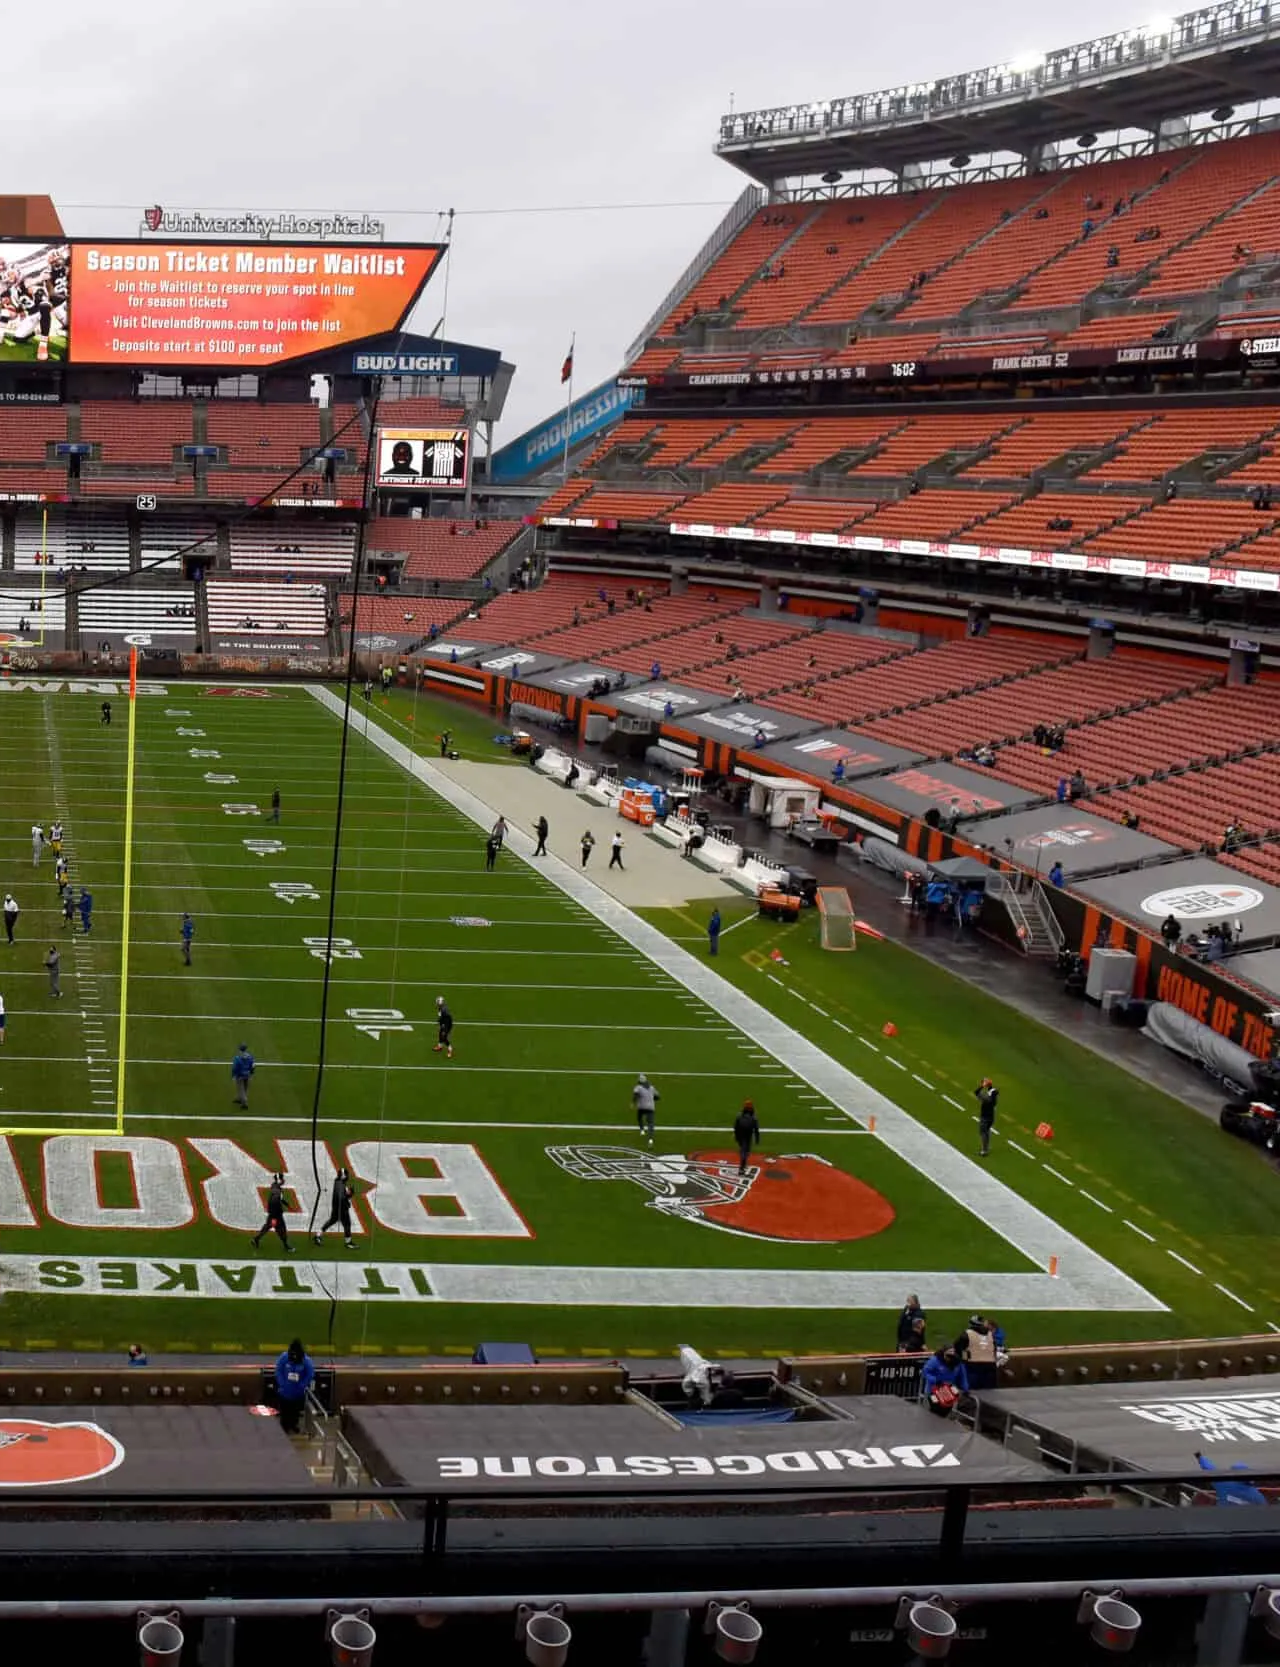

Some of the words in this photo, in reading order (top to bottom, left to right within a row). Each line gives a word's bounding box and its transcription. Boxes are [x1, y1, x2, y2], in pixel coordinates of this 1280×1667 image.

[163, 214, 271, 239] University
[278, 215, 380, 238] Hospitals
[87, 251, 160, 272] Season
[166, 252, 230, 273] Ticket
[235, 252, 318, 274] Member
[323, 253, 405, 275] Waitlist
[114, 280, 136, 294] Join
[139, 280, 157, 293] the
[160, 280, 204, 294] Waitlist
[207, 282, 218, 294] to
[221, 283, 263, 295] reserve
[266, 284, 290, 298] your
[293, 283, 317, 297] spot
[320, 283, 331, 295] in
[333, 283, 356, 296] line
[128, 295, 145, 309] for
[146, 297, 186, 309] season
[189, 295, 229, 309] tickets
[112, 315, 138, 329] Visit
[141, 316, 260, 331] ClevelandBrowns.com
[262, 318, 274, 331] to
[276, 318, 299, 333] join
[300, 318, 319, 332] the
[321, 319, 342, 332] list
[112, 338, 160, 354] Deposits
[163, 340, 191, 353] start
[194, 340, 206, 353] at
[208, 340, 236, 354] $100
[238, 342, 257, 356] per
[259, 342, 284, 354] seat
[1147, 345, 1179, 361] KELLY
[1182, 343, 1198, 359] 44
[356, 356, 395, 371] BUD
[398, 357, 455, 371] LIGHT
[992, 356, 1020, 370] FRANK
[6, 393, 16, 401] TO
[139, 496, 154, 508] 25
[1157, 964, 1211, 1022] HOME
[1210, 995, 1239, 1039] OF
[345, 1008, 415, 1032] 10
[39, 1259, 314, 1296] TAKES
[360, 1267, 434, 1296] IT
[440, 1443, 962, 1479] BRIDGESTONE
